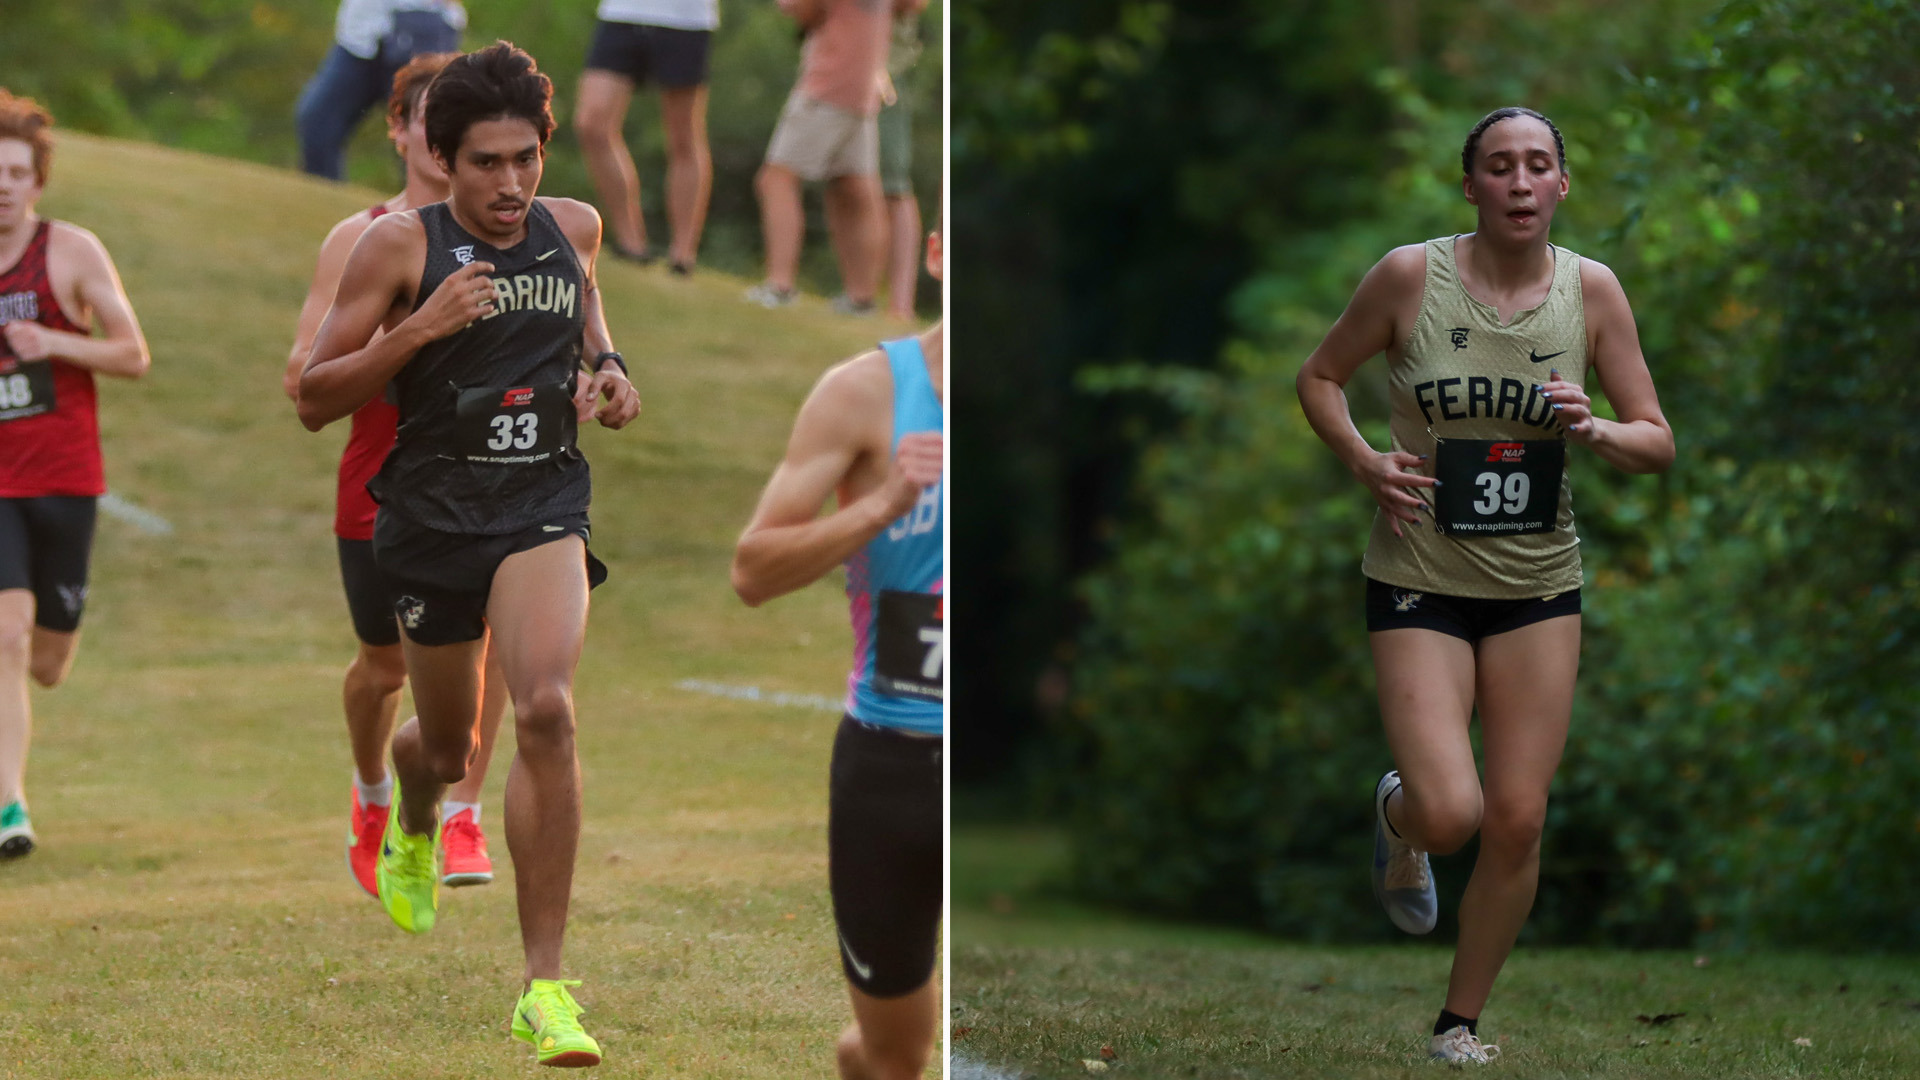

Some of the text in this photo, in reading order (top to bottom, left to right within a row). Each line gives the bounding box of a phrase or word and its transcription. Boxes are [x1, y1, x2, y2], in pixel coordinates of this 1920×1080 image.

[1415, 376, 1564, 434] FERRU
[487, 412, 538, 451] 33
[467, 452, 550, 464] www.snaptiming.com
[1486, 442, 1526, 462] SNAP
[1473, 472, 1530, 515] 39
[1452, 521, 1542, 532] www.snaptiming.com
